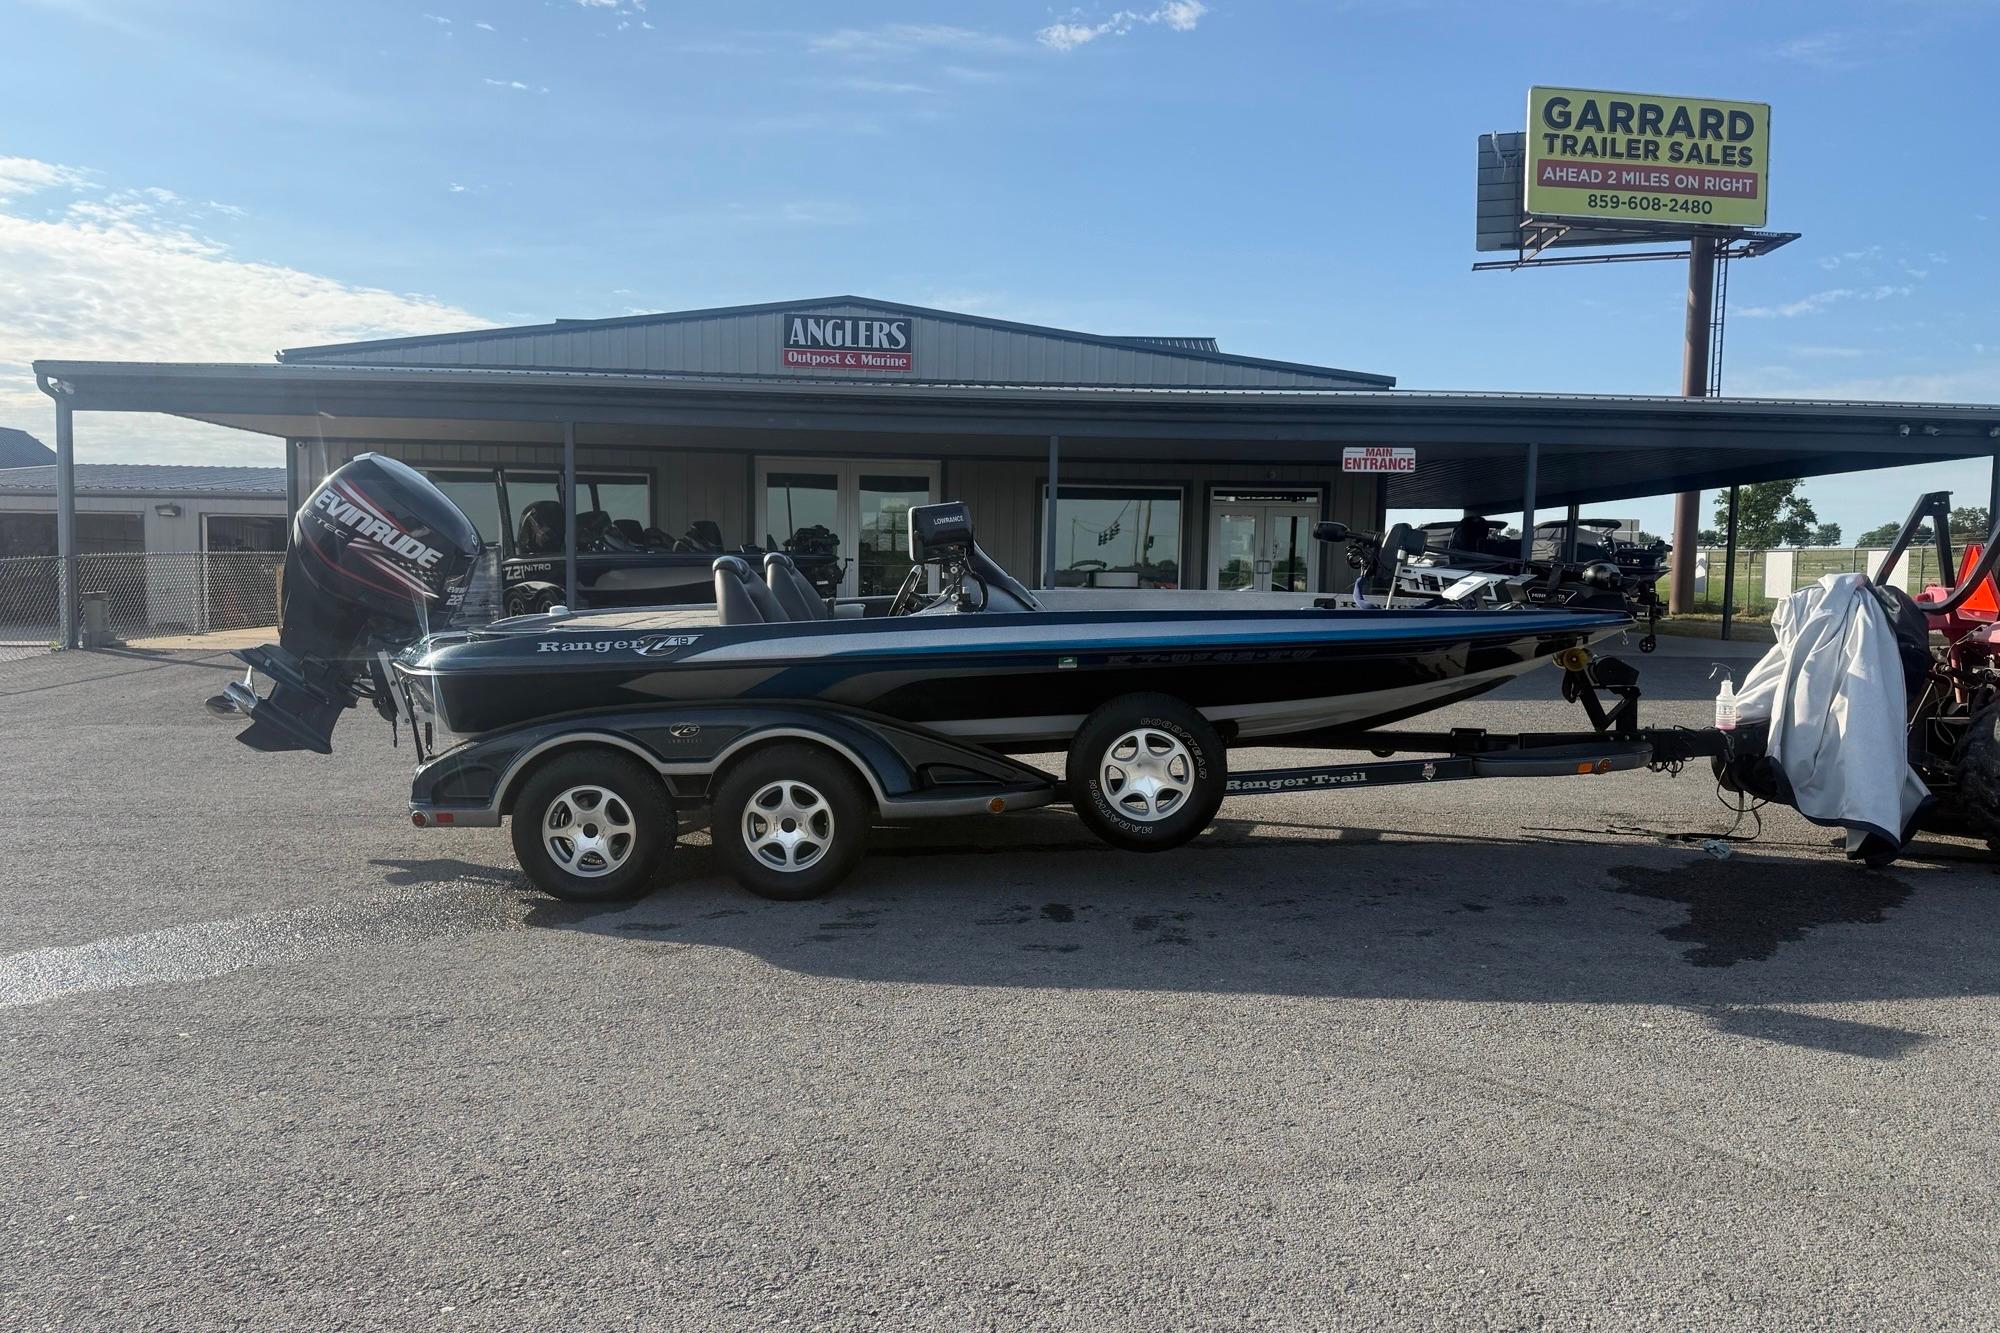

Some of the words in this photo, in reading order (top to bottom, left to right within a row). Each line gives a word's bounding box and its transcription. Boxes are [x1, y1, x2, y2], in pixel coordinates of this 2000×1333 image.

[1542, 96, 1755, 143] GARRARD
[1543, 132, 1660, 162] TRAILER
[1667, 140, 1754, 168] SALES
[1542, 166, 1602, 184] AHEAD
[1607, 170, 1617, 185] 2
[1621, 171, 1670, 187] MILES
[1675, 173, 1699, 189] ON
[1704, 176, 1754, 193] RIGHT
[1587, 193, 1713, 215] 859-608-2480
[789, 317, 907, 349] ANGLERS
[787, 351, 841, 366] Outpost
[844, 353, 857, 365] &
[861, 354, 907, 367] Marine
[1344, 457, 1415, 470] ENTRANCE
[1365, 448, 1393, 457] MAIN
[303, 508, 350, 540] E-TEC
[314, 488, 445, 569] EVINRUDE
[933, 515, 964, 525] LOWRANCE
[503, 565, 525, 580] Z21
[536, 639, 645, 653] Ranger
[1140, 717, 1208, 780] GOODYEAR
[1225, 777, 1308, 791] Ranger
[1312, 772, 1367, 785] Trail
[1088, 779, 1153, 834] MARATHON
